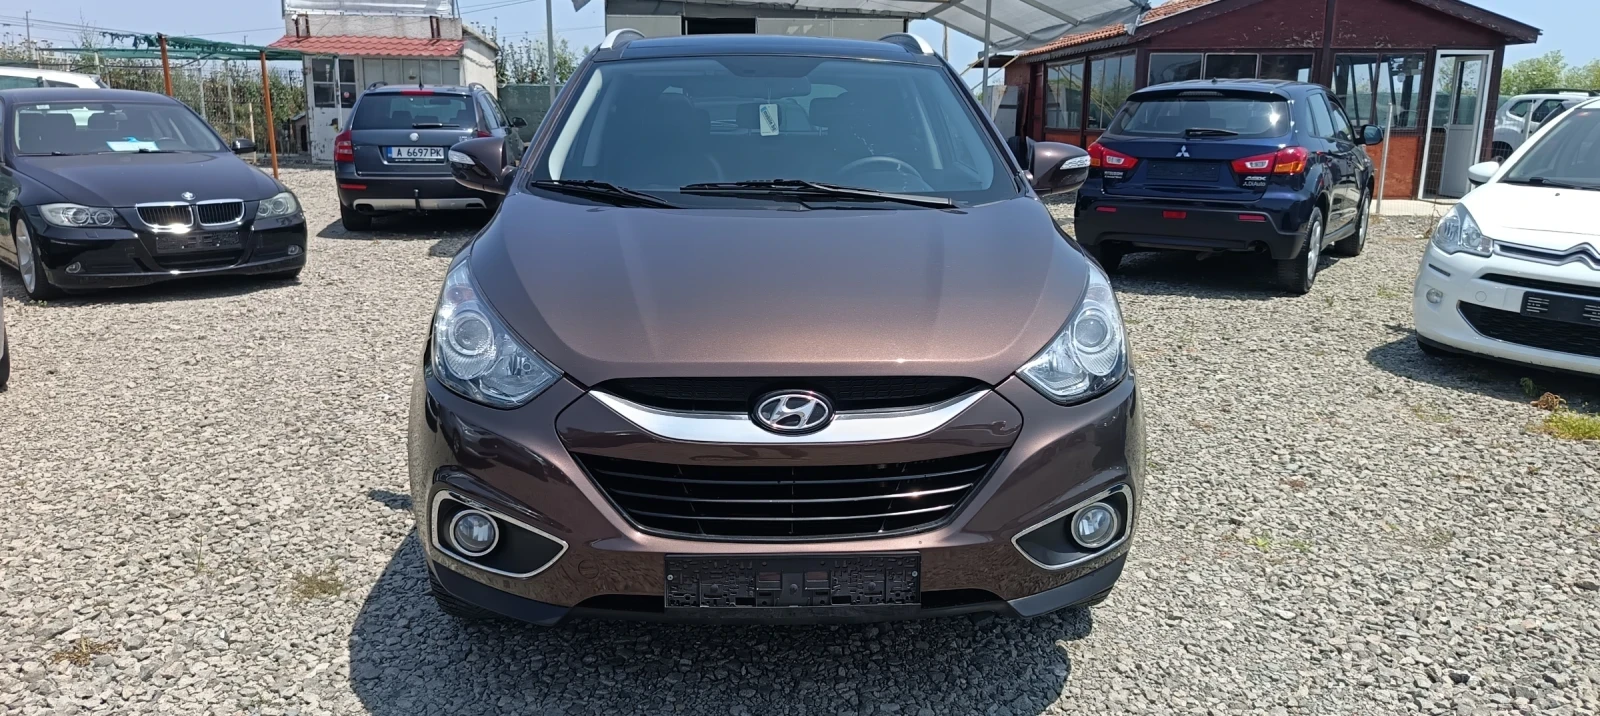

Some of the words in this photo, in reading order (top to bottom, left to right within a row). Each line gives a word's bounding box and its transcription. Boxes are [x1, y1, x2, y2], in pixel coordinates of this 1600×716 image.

[396, 148, 403, 157] A
[406, 148, 429, 157] 6697
[430, 148, 442, 157] PK
